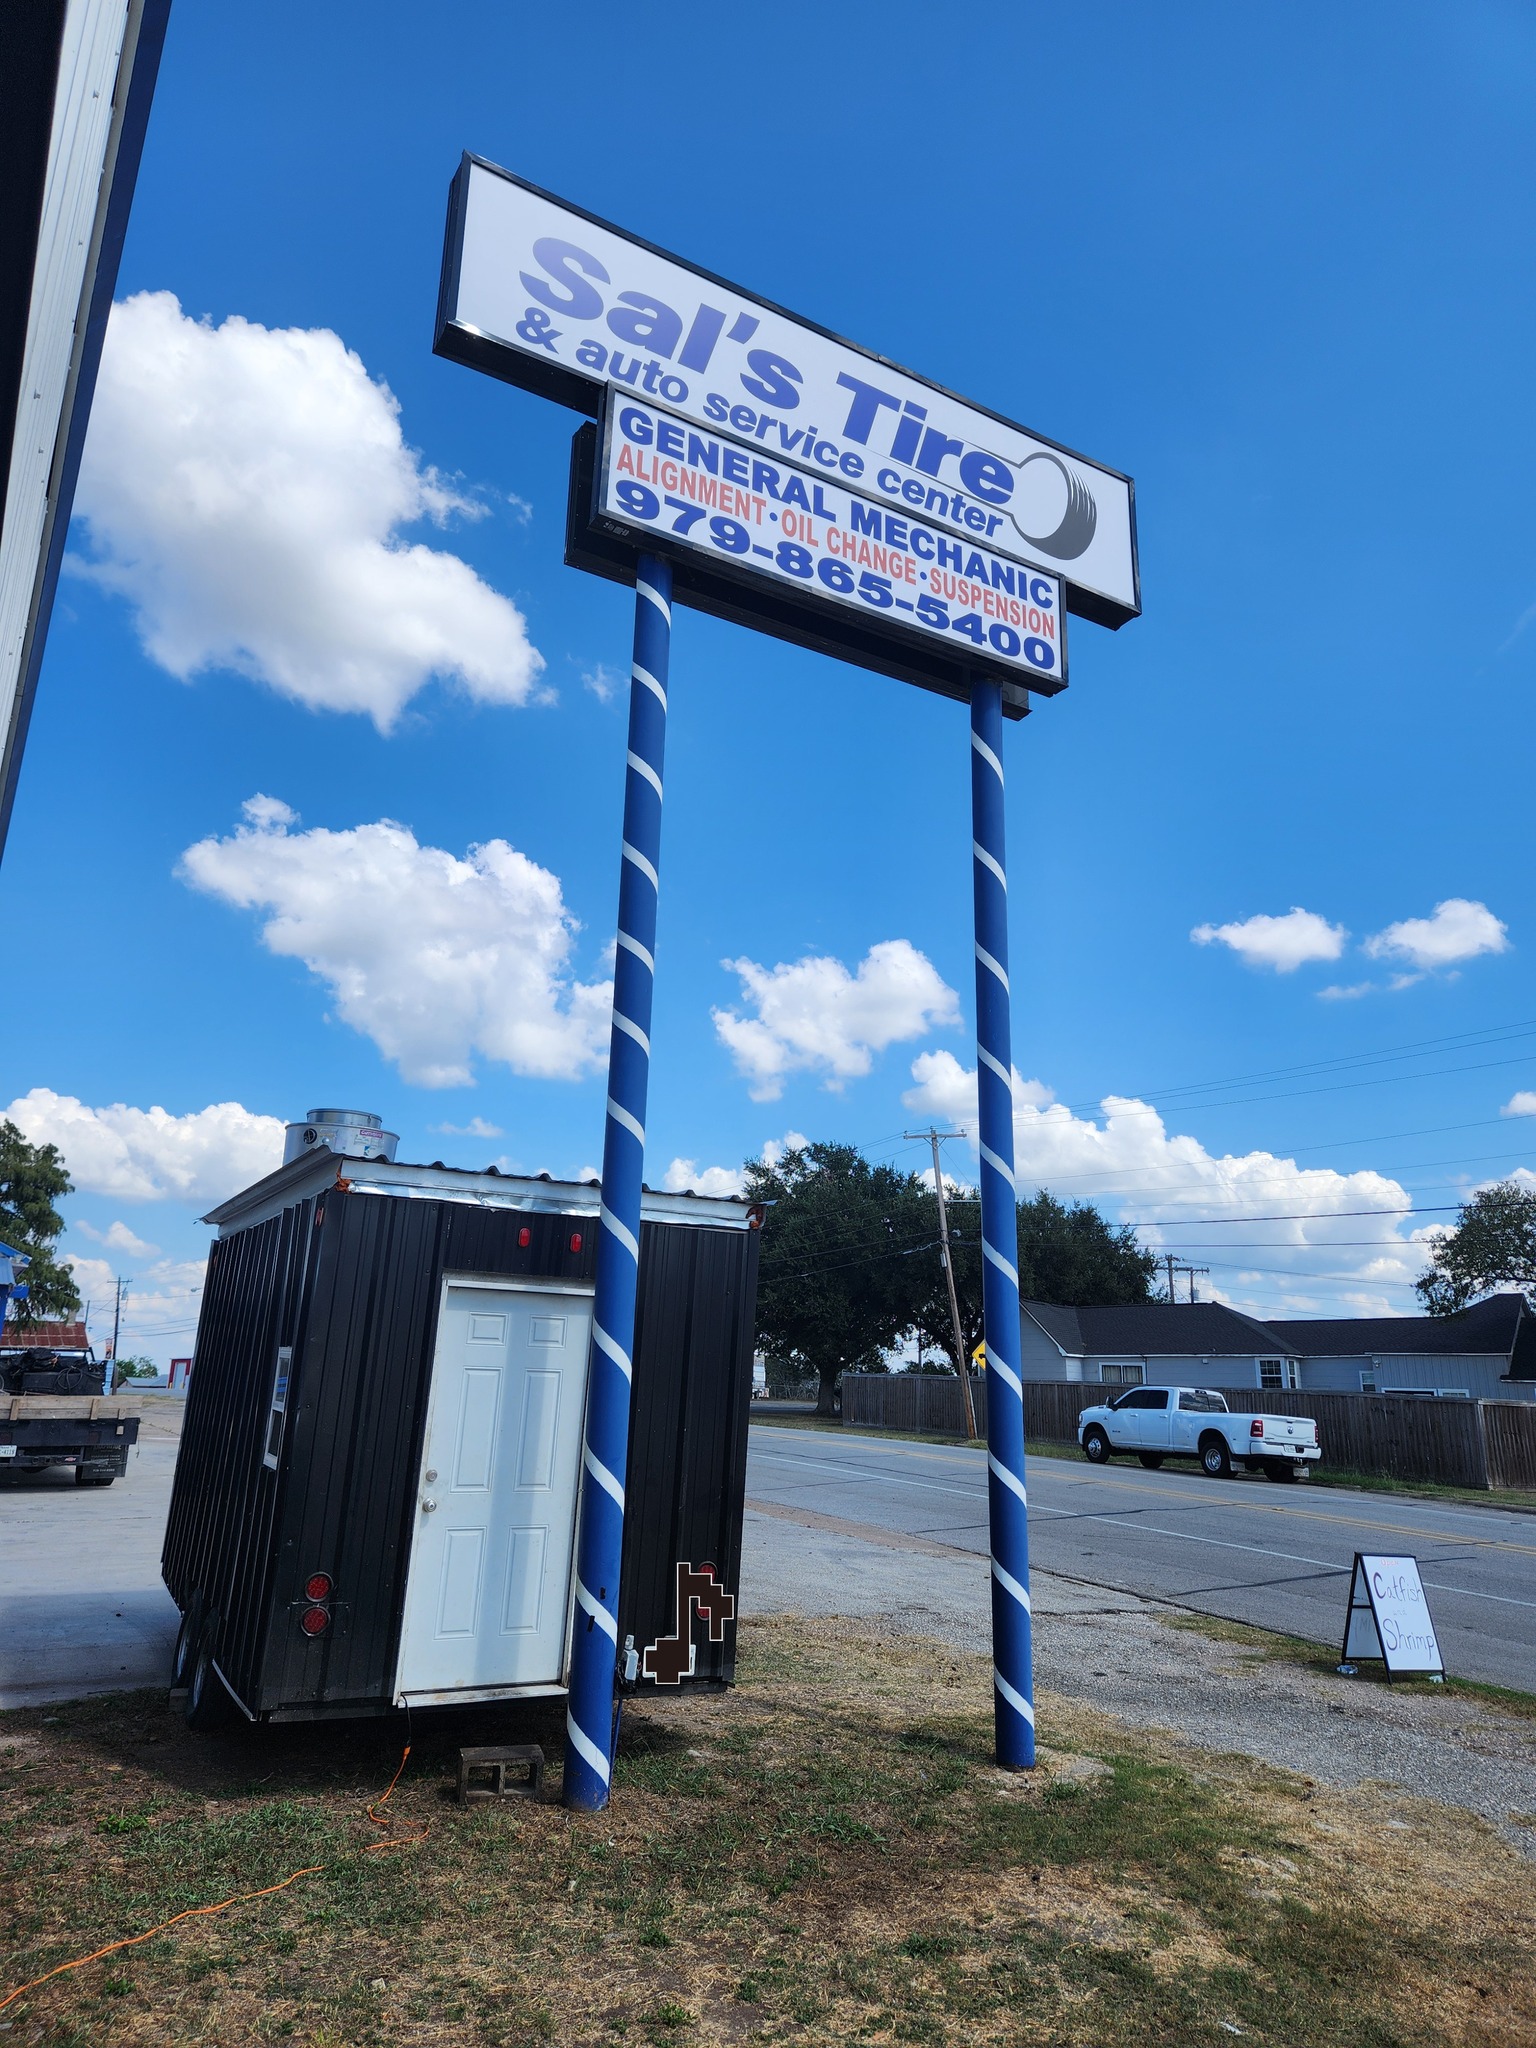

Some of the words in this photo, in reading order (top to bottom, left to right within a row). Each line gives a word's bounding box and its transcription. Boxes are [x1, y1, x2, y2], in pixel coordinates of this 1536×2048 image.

[515, 307, 563, 354] &
[575, 338, 689, 403] auto
[702, 393, 865, 478] service
[877, 468, 1003, 538] center
[519, 237, 804, 410] Sal's
[836, 371, 1015, 505] Tire
[615, 479, 1056, 671] 979-865-5400
[616, 443, 767, 526] ALIGNMENT
[781, 508, 819, 548] OIL
[826, 527, 917, 586] CHANGE
[930, 568, 1055, 640] SUSPENSION
[619, 407, 836, 522] GENERAL
[850, 499, 1054, 609] MECHANIC
[1373, 1571, 1426, 1602] Catfish
[1382, 1618, 1434, 1660] Shrimp
